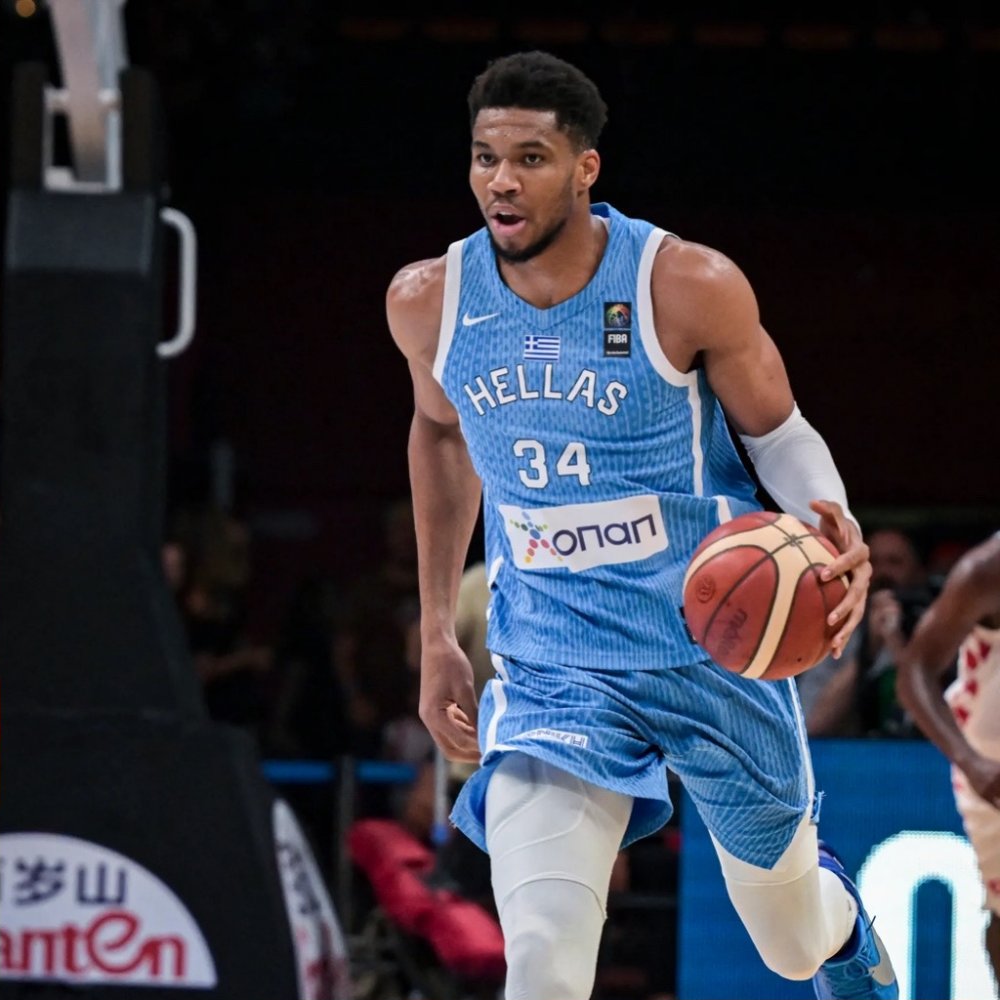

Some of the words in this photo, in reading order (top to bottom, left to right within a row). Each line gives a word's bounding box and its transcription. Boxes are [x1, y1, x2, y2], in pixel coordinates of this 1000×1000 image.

[607, 334, 628, 344] FIBA
[463, 364, 628, 416] HELLAS
[512, 439, 591, 489] 34
